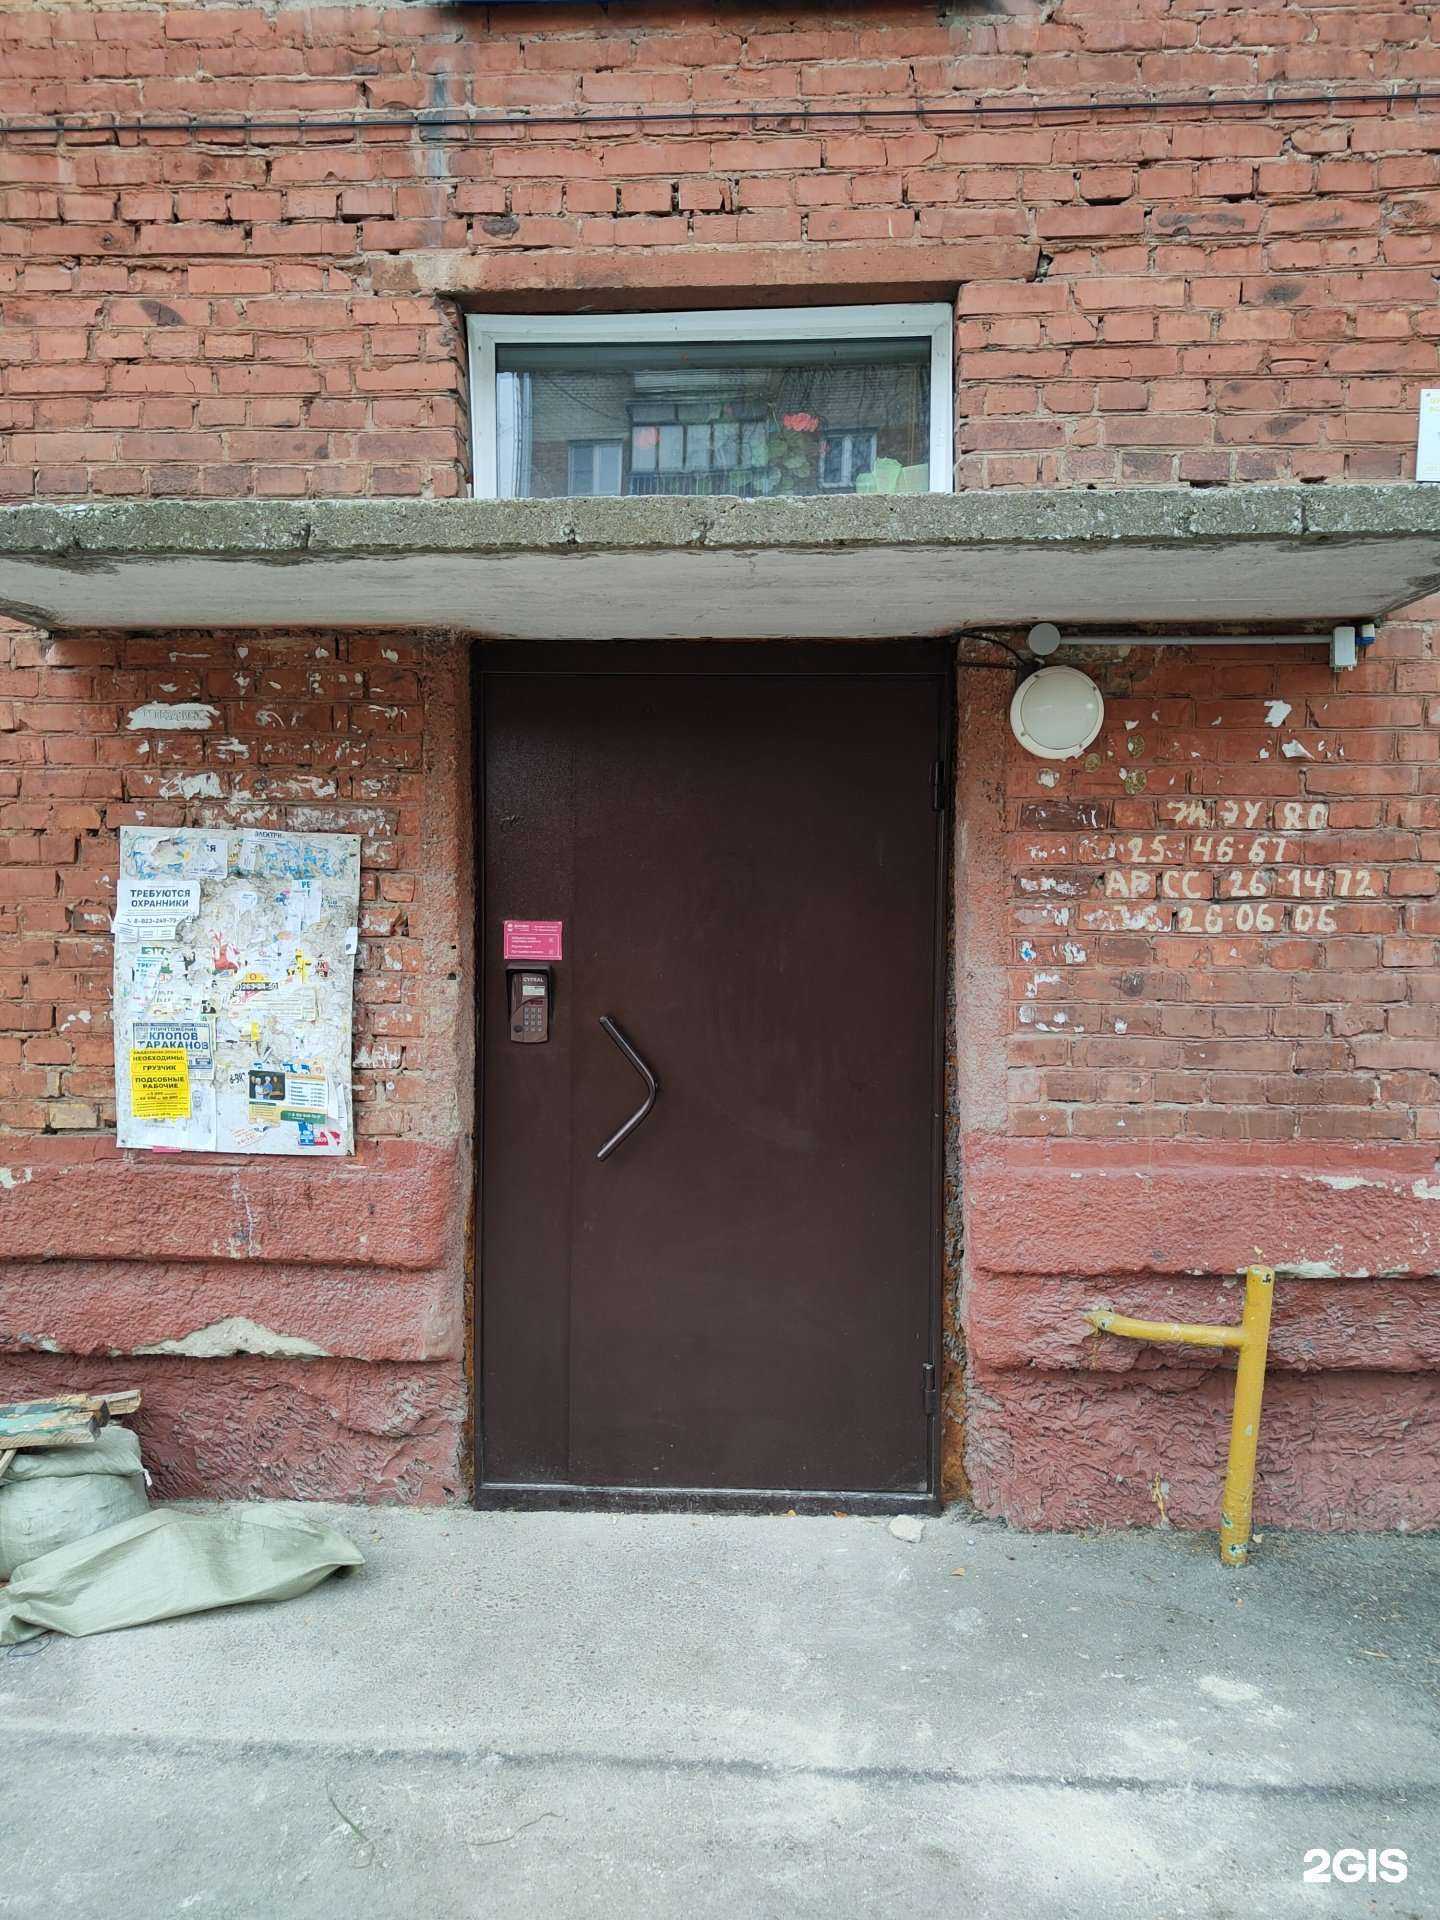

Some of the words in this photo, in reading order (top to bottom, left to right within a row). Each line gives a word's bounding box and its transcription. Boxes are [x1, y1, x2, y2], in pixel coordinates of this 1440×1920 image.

[130, 889, 191, 898] ТРЕБУЮТСЯ
[149, 1032, 198, 1041] КЛОПОВ
[137, 1040, 209, 1050] ТАРАКАНОВ
